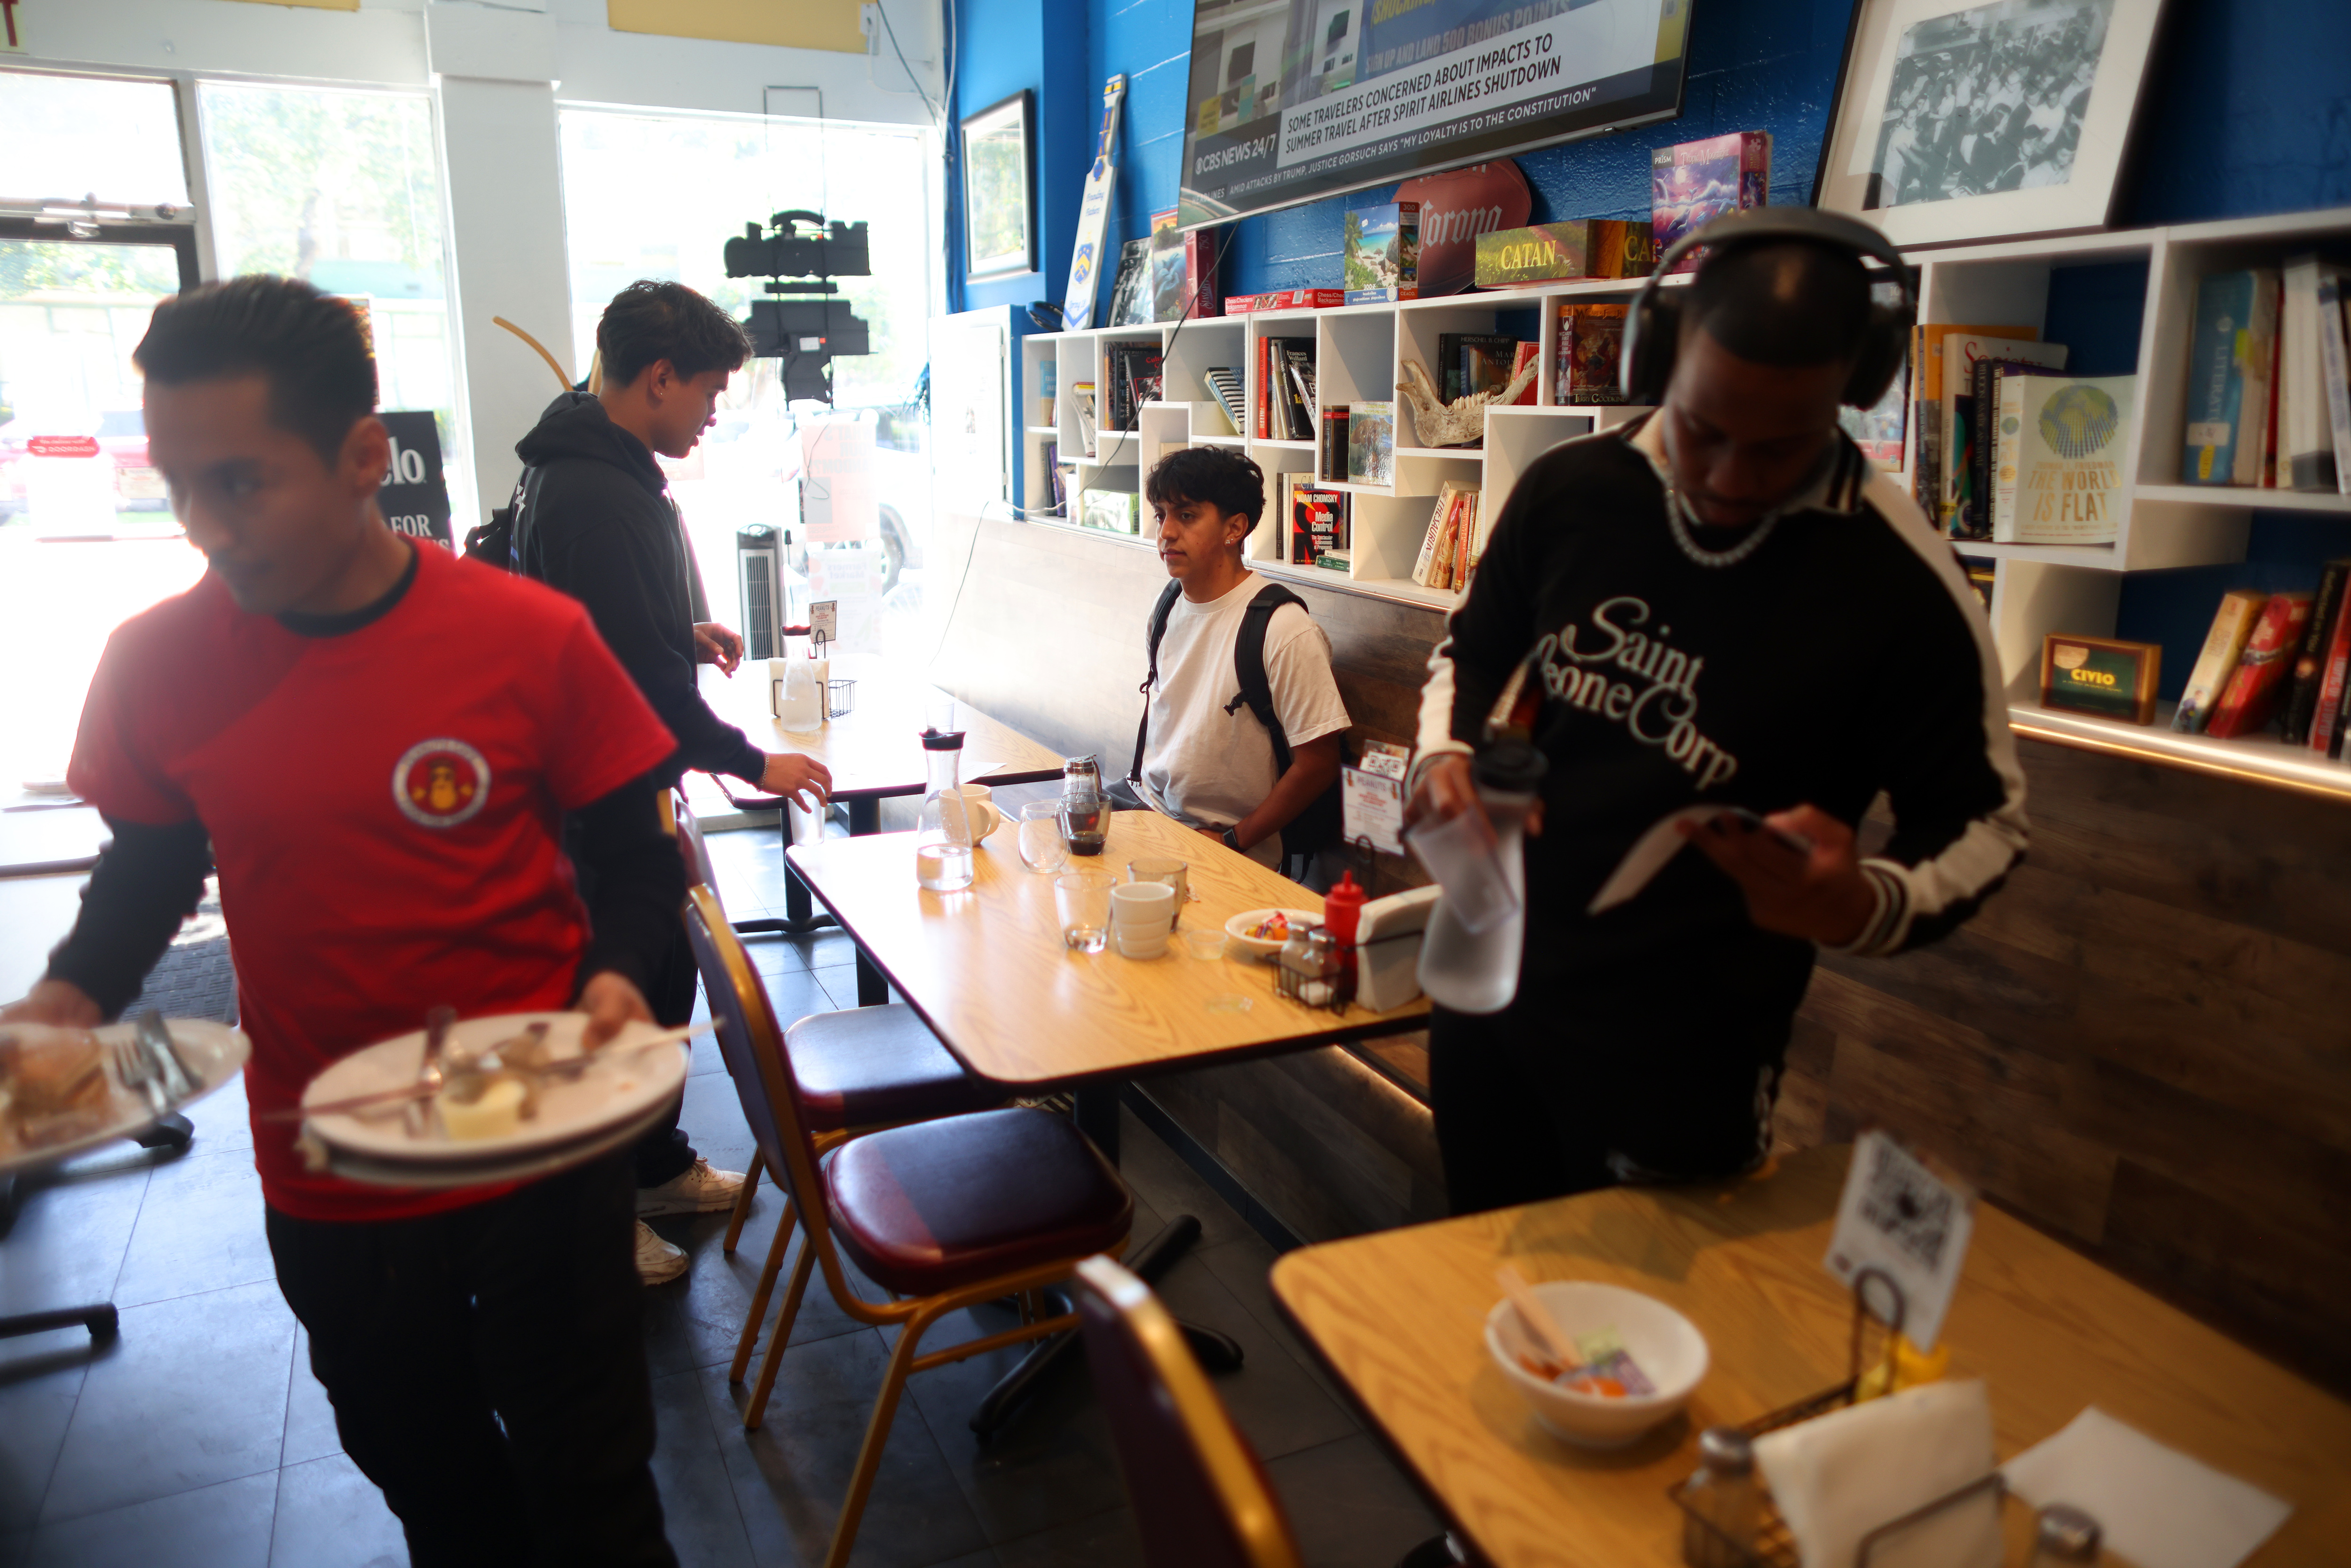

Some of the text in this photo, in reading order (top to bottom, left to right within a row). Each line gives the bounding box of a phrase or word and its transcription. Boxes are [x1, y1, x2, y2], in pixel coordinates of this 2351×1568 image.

[1365, 52, 1384, 73] SIGN
[1384, 48, 1396, 69] UP
[1396, 42, 1415, 66] AND
[1415, 34, 1441, 62] LAND
[1442, 27, 1465, 53] 500
[1466, 12, 1510, 46] BONUS
[1287, 32, 1553, 134] SOME TRAVELERS CONCERNED ABOUT IMPACTS TO
[1286, 55, 1561, 153] SUMMER TRAVEL AFTER SPIRIT AIRLINES SHUTDOWN
[1202, 133, 1277, 172] CBS NEWS 24/7
[1229, 87, 1596, 195] AMID ATTACKS BY TRUMP, JUSTICE GORSUCH SAYS "MY LOYALTY IS TO THE CONSTITUTION"
[1680, 152, 1700, 169] Tropic
[1700, 148, 1730, 166] Moonlight
[1500, 240, 1557, 270] CATAN
[1978, 363, 1987, 399] RELIGION
[1977, 402, 1985, 443] AMERICAN
[2028, 470, 2122, 490] THE WORLD
[1297, 494, 1338, 503] NOAM CHOMSKY
[2033, 492, 2108, 522] IS FLAT
[390, 514, 432, 536] FOR
[1311, 522, 1333, 532] Control
[1315, 511, 1333, 522] Media
[2306, 570, 2336, 653] Reflected in You
[1559, 595, 1704, 701] Saint
[2071, 668, 2115, 685] CIVIO
[1628, 681, 1738, 791] Corp
[2318, 701, 2338, 736] STUPID
[1357, 777, 1387, 792] PEANUTS
